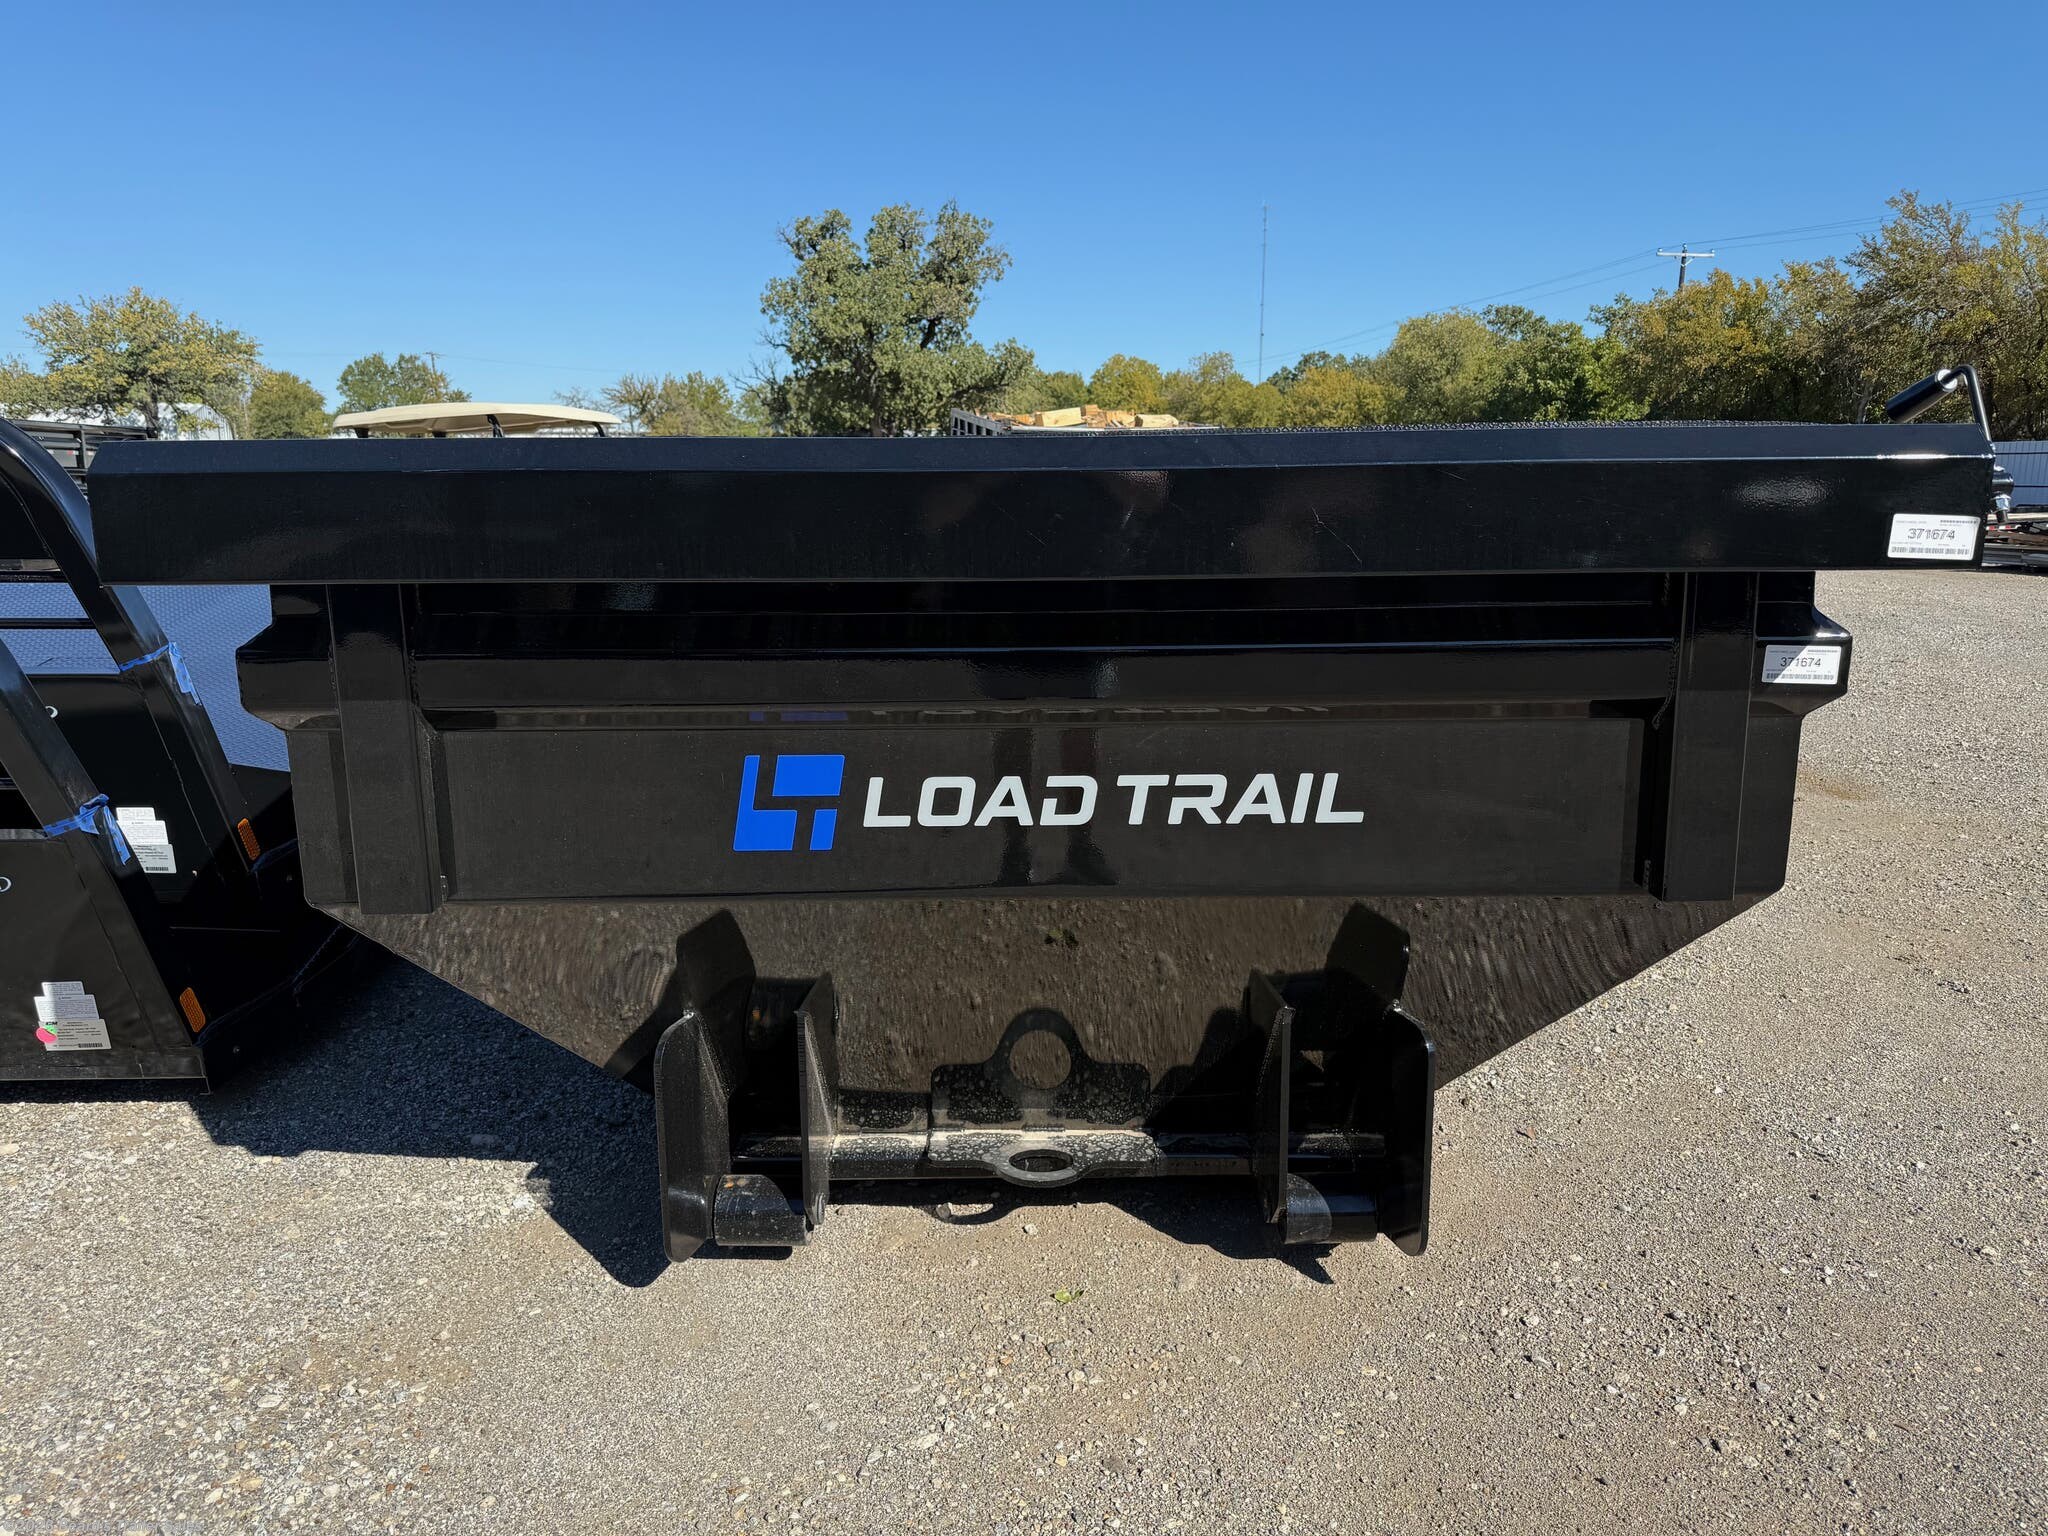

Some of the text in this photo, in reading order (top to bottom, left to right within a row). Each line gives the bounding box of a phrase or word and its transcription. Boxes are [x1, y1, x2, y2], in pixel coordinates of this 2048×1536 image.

[1907, 528, 1955, 540] 371674
[1780, 656, 1821, 668] 371674
[862, 772, 1365, 828] LOAD TRAIL
